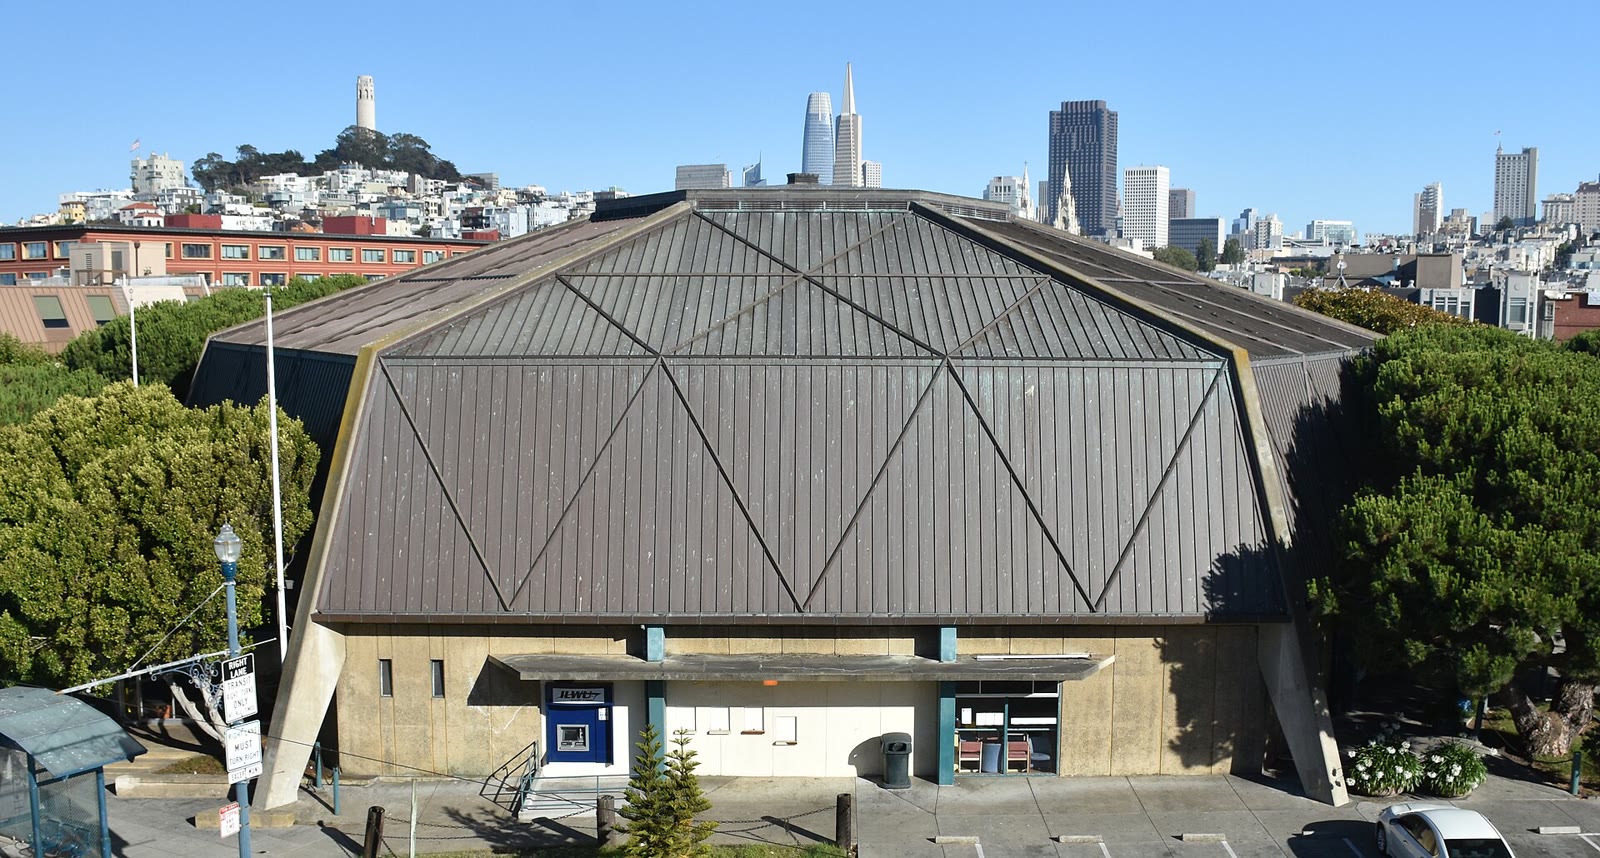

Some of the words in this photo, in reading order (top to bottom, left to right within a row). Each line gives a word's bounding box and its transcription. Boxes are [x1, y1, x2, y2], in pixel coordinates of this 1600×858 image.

[228, 657, 248, 670] RIGHT
[230, 666, 247, 679] LANE
[227, 675, 251, 690] TRANSIT
[560, 690, 593, 699] ILWU
[233, 697, 248, 709] ONLY
[234, 739, 252, 752] MUST
[229, 756, 243, 765] TURN
[244, 751, 259, 760] RIGHT
[231, 768, 247, 781] EXCEPT
